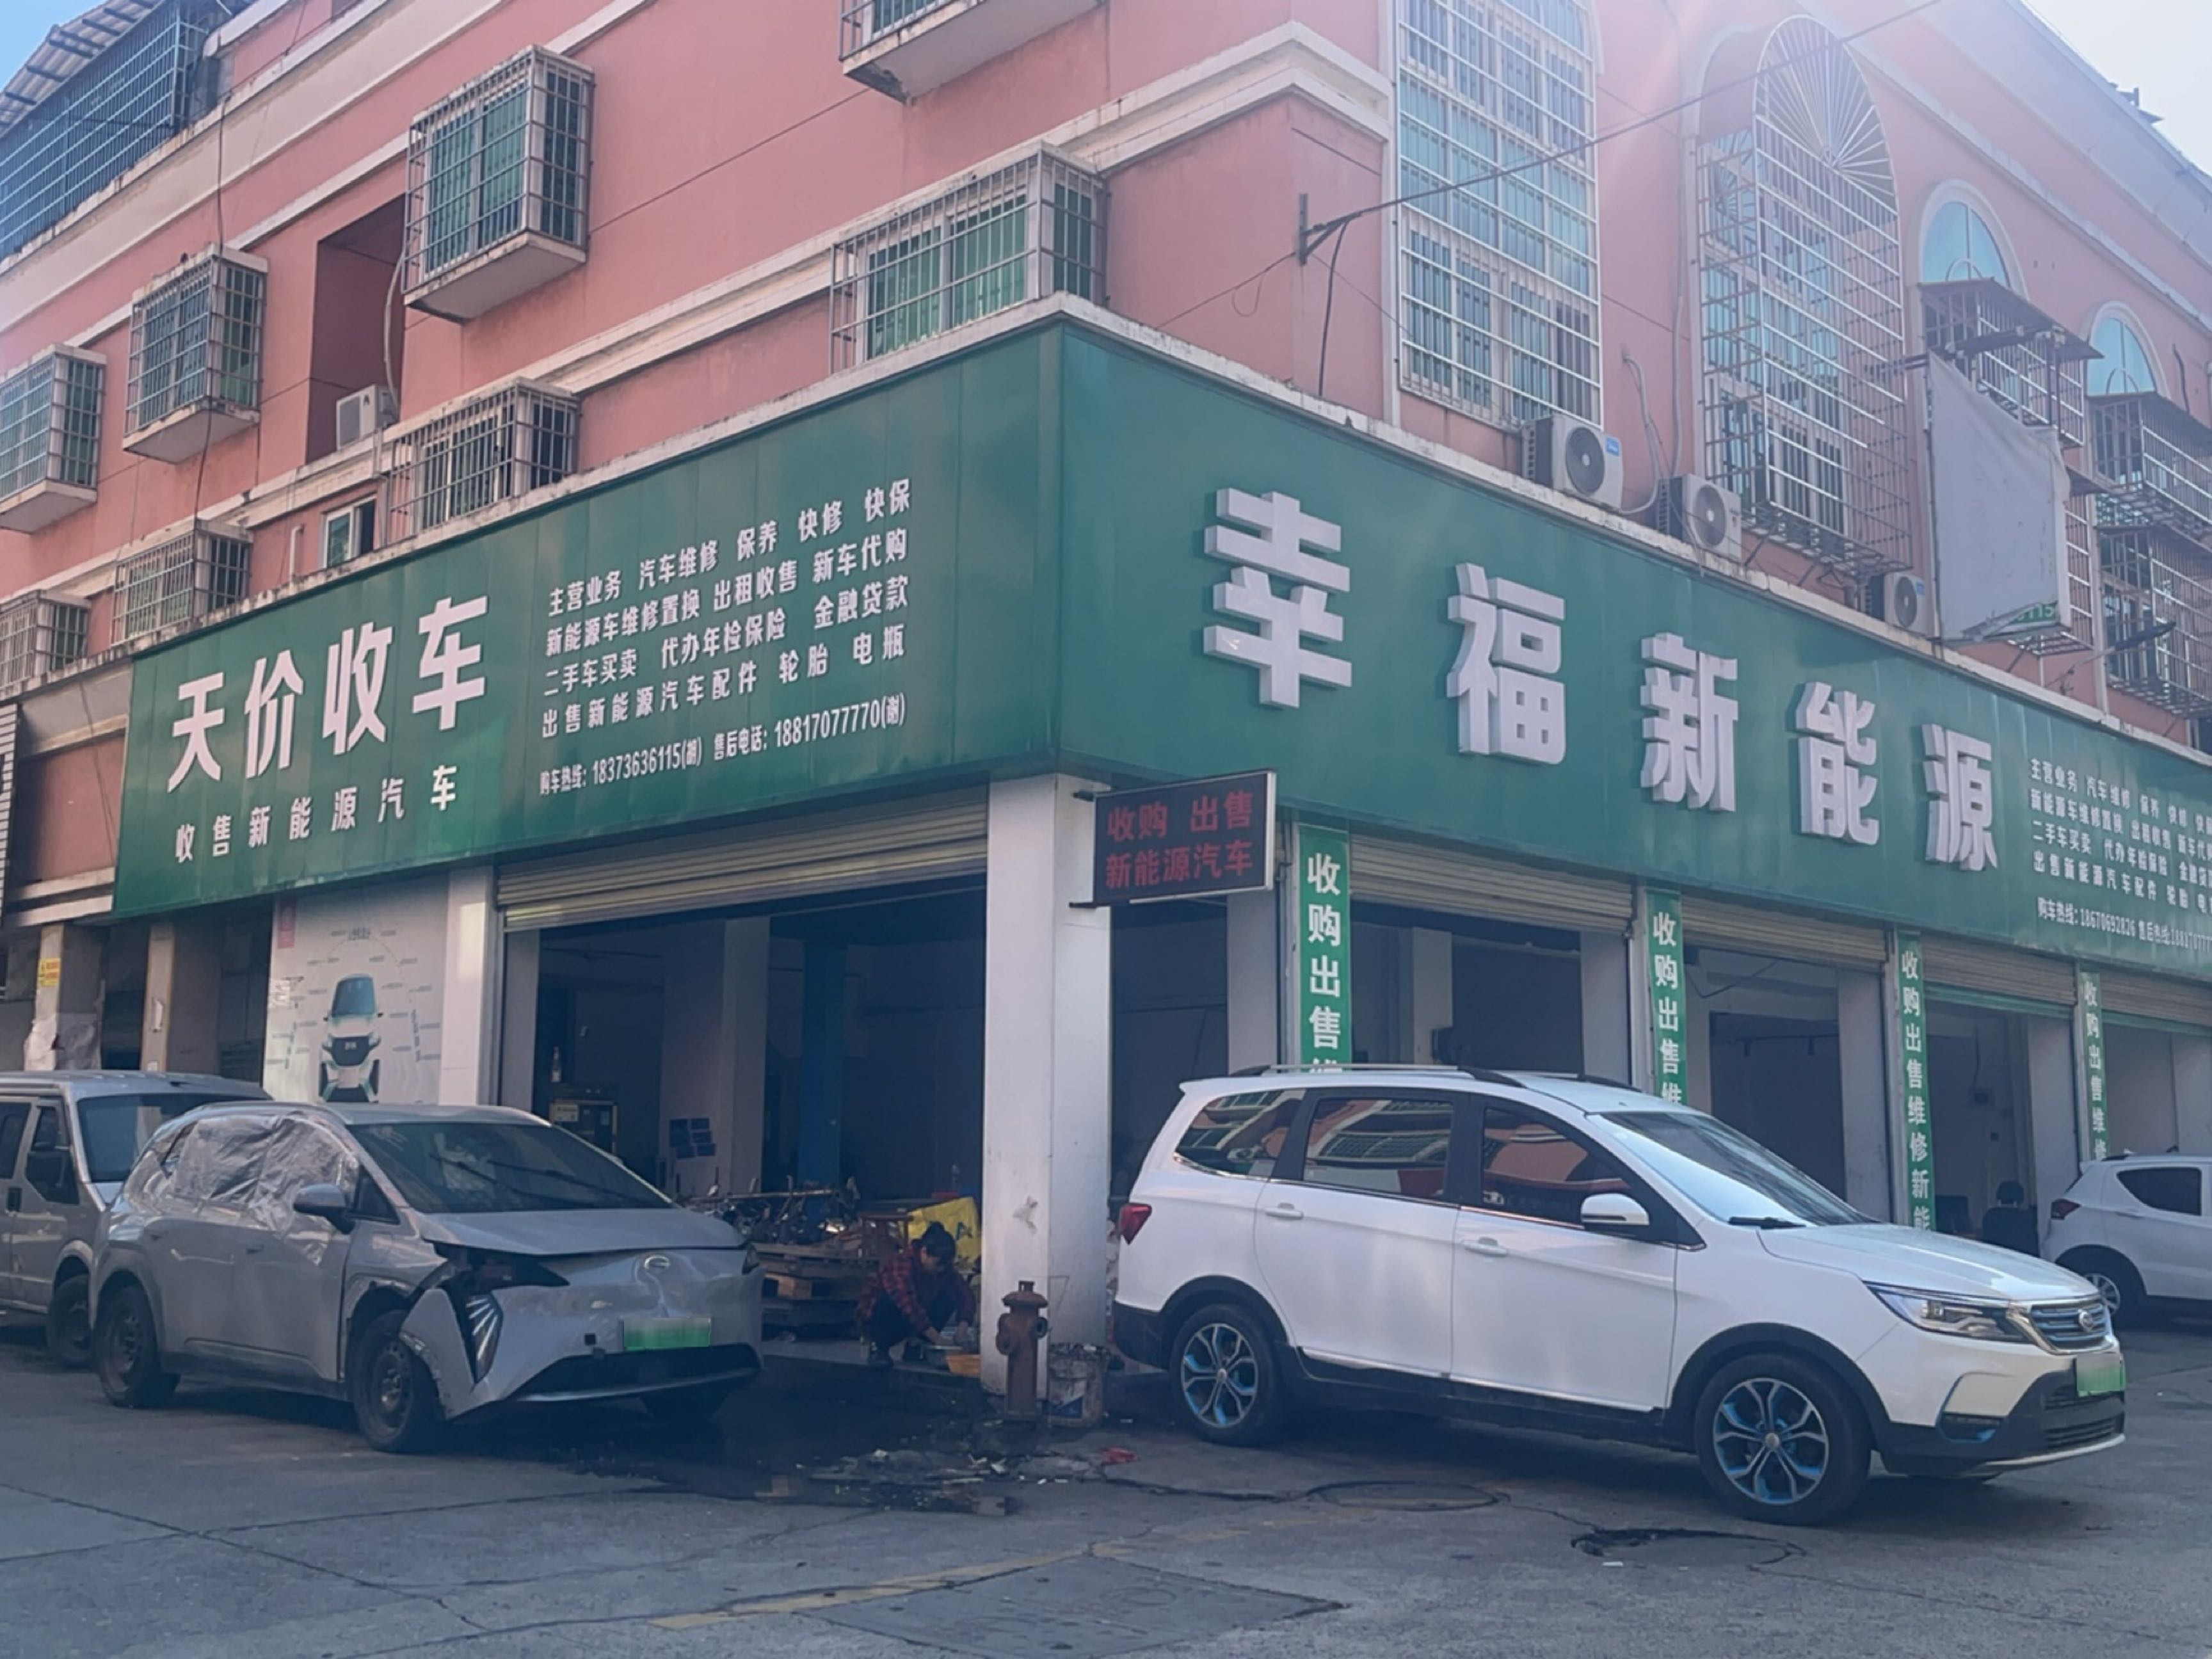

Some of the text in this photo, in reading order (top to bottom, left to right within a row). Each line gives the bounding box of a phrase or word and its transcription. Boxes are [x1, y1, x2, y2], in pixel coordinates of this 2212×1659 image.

[545, 527, 908, 657] 新能源车维修置换 出租收售 新车代购
[549, 478, 910, 617] 主营业务 汽车维修 保养 快修 快保
[168, 595, 488, 794] 天价收车
[541, 623, 905, 738] 出售新能源汽车配件 轮胎 电瓶
[544, 576, 908, 696] 二手车买卖 代办年检保险 金融贷款
[1203, 486, 1999, 872] 幸福新能源
[175, 765, 457, 863] 收售新能源汽车
[1105, 840, 1253, 889] 新能源汽车
[1107, 790, 1254, 842] 收购 出售
